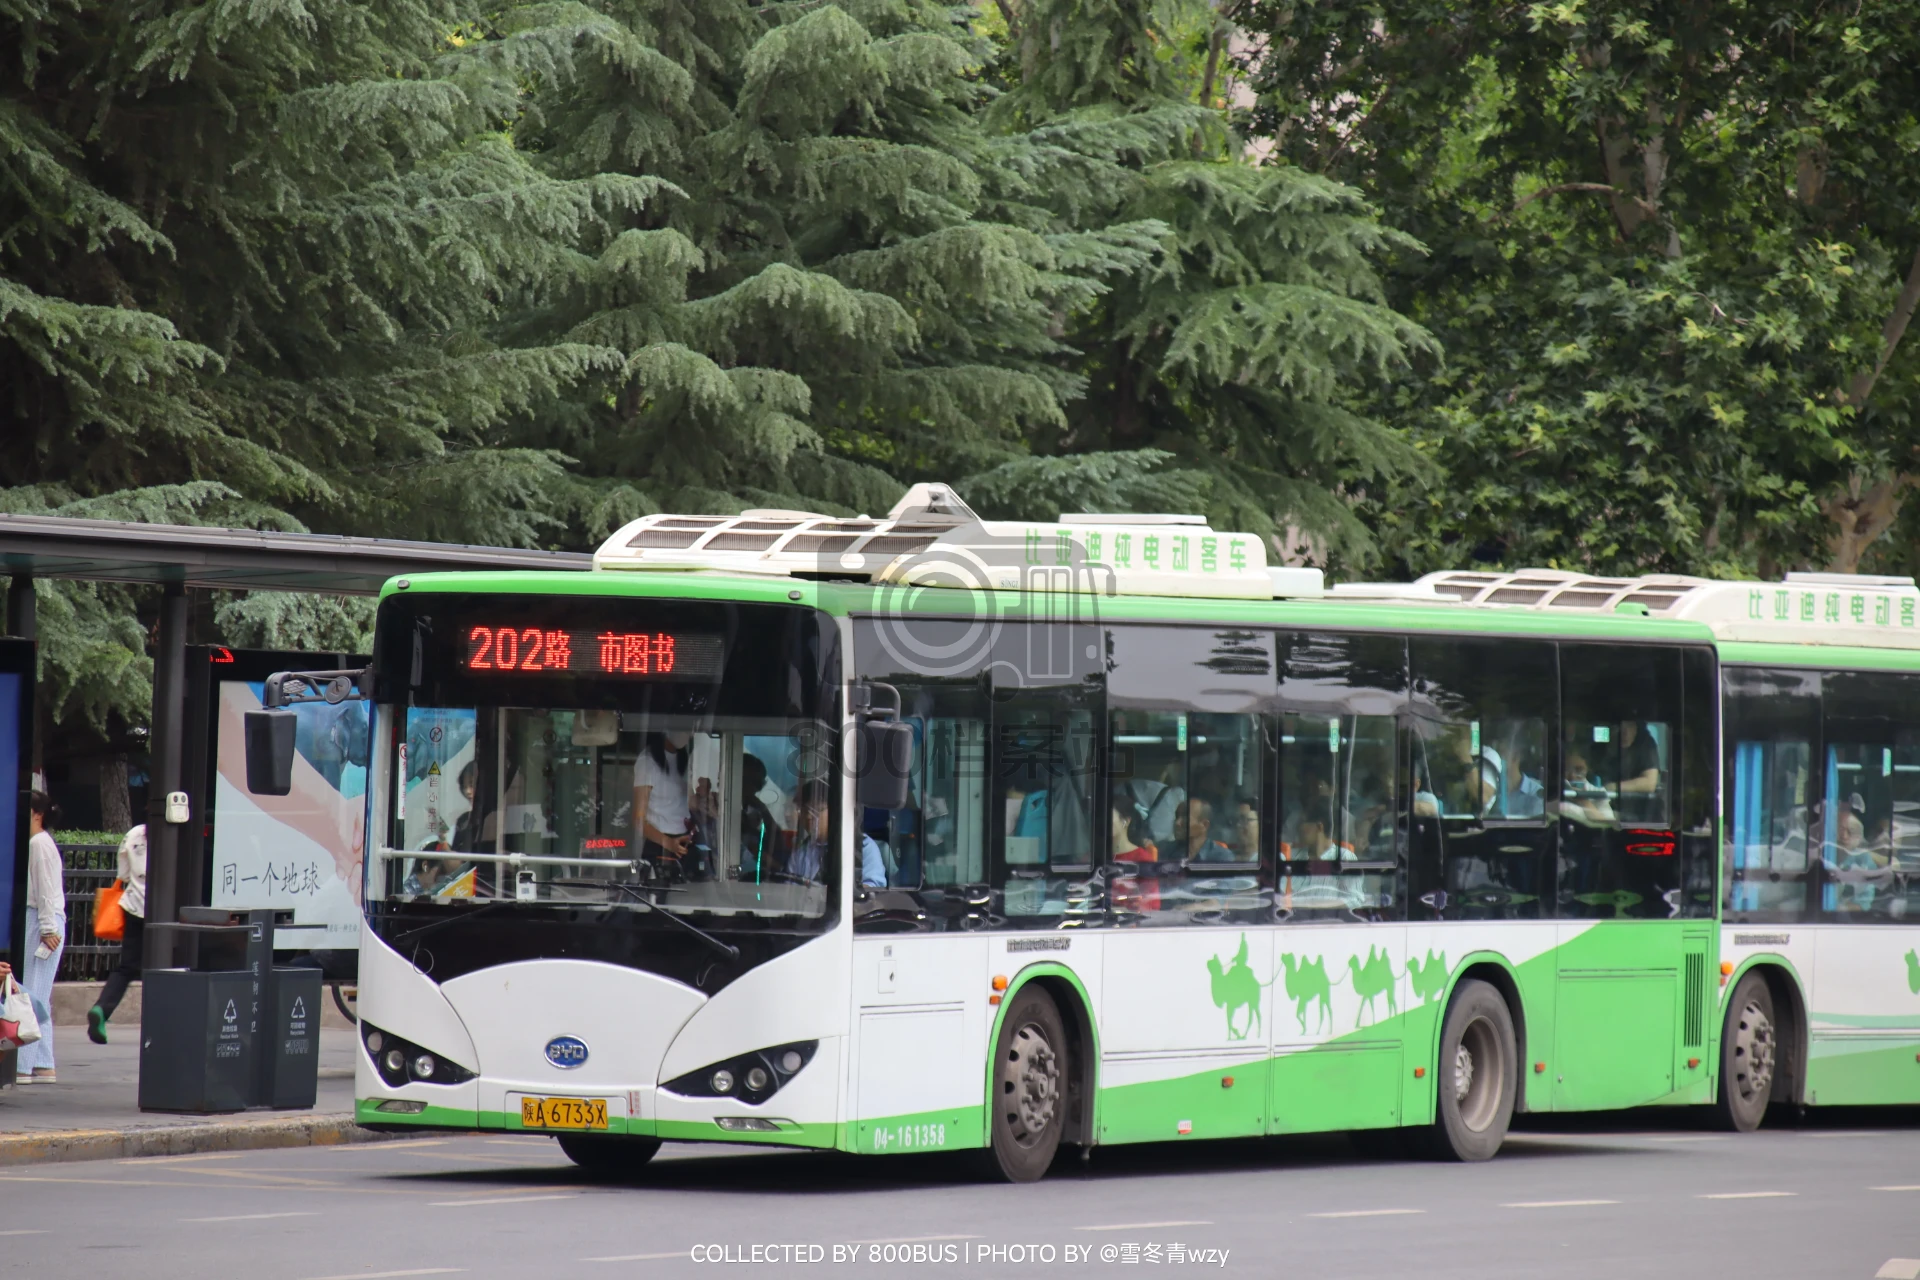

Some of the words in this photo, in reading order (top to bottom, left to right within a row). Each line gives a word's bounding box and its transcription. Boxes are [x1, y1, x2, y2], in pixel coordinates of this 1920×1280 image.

[1025, 528, 1247, 573] 比亚迪纯电动客车
[1749, 588, 1916, 627] 比亚迪纯电动客
[470, 627, 570, 670] 202路
[597, 631, 674, 673] 市图书
[222, 861, 321, 897] 同一个地球
[549, 1044, 585, 1059] BYD
[874, 1125, 946, 1149] 04-161358
